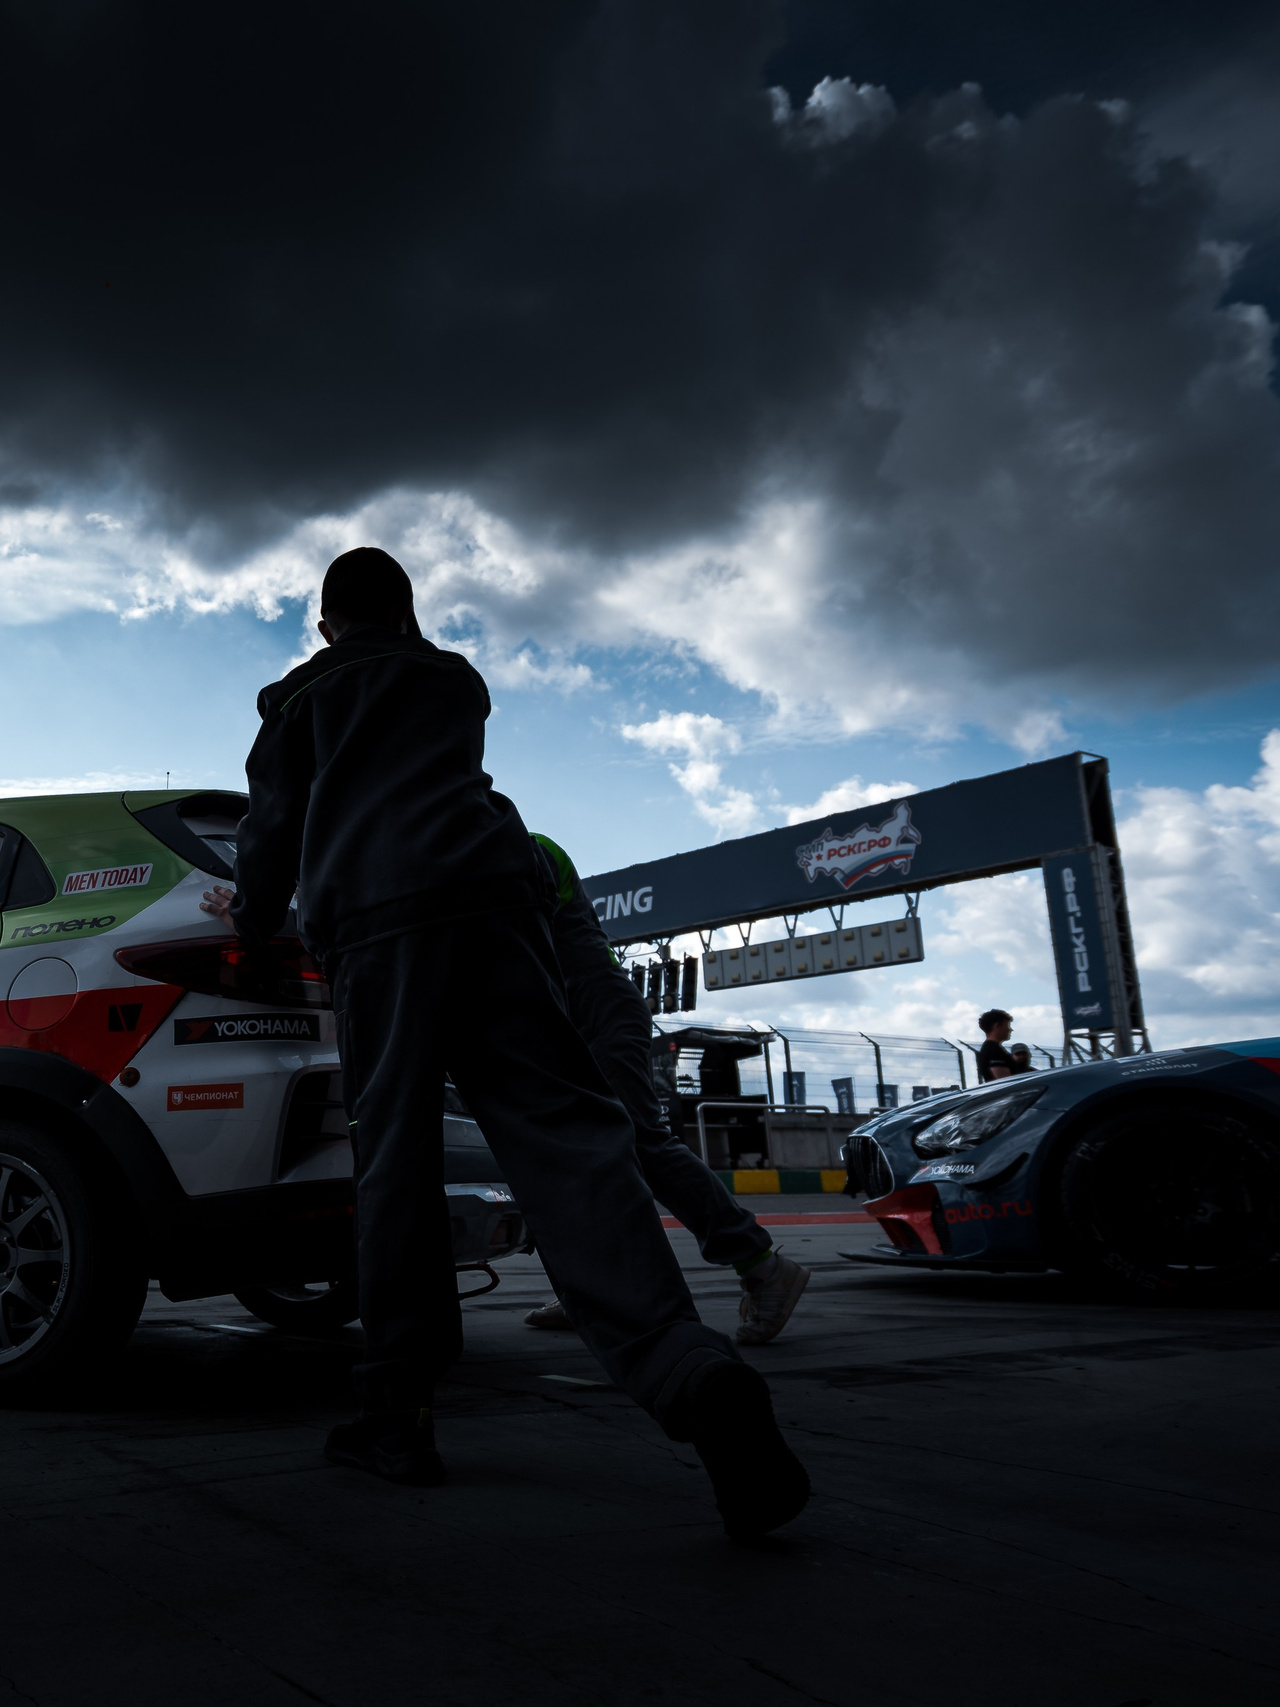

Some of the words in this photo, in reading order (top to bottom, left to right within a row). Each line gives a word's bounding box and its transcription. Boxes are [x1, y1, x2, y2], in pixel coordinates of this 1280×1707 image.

[827, 836, 892, 861] РСКГ.РФ
[65, 872, 99, 893] MEN
[100, 866, 150, 888] TODAY
[592, 886, 654, 922] CING
[11, 915, 116, 940] ПОЛЕНО
[1062, 867, 1093, 992] РСКГ.РФ
[214, 1019, 311, 1037] YOKOHAMA
[1121, 1063, 1199, 1076] СТАНКОЛИТ
[184, 1091, 239, 1102] ЧЕМПИОНАТ
[931, 1164, 975, 1175] YOKOHAMA
[945, 1200, 1034, 1225] auto.ru
